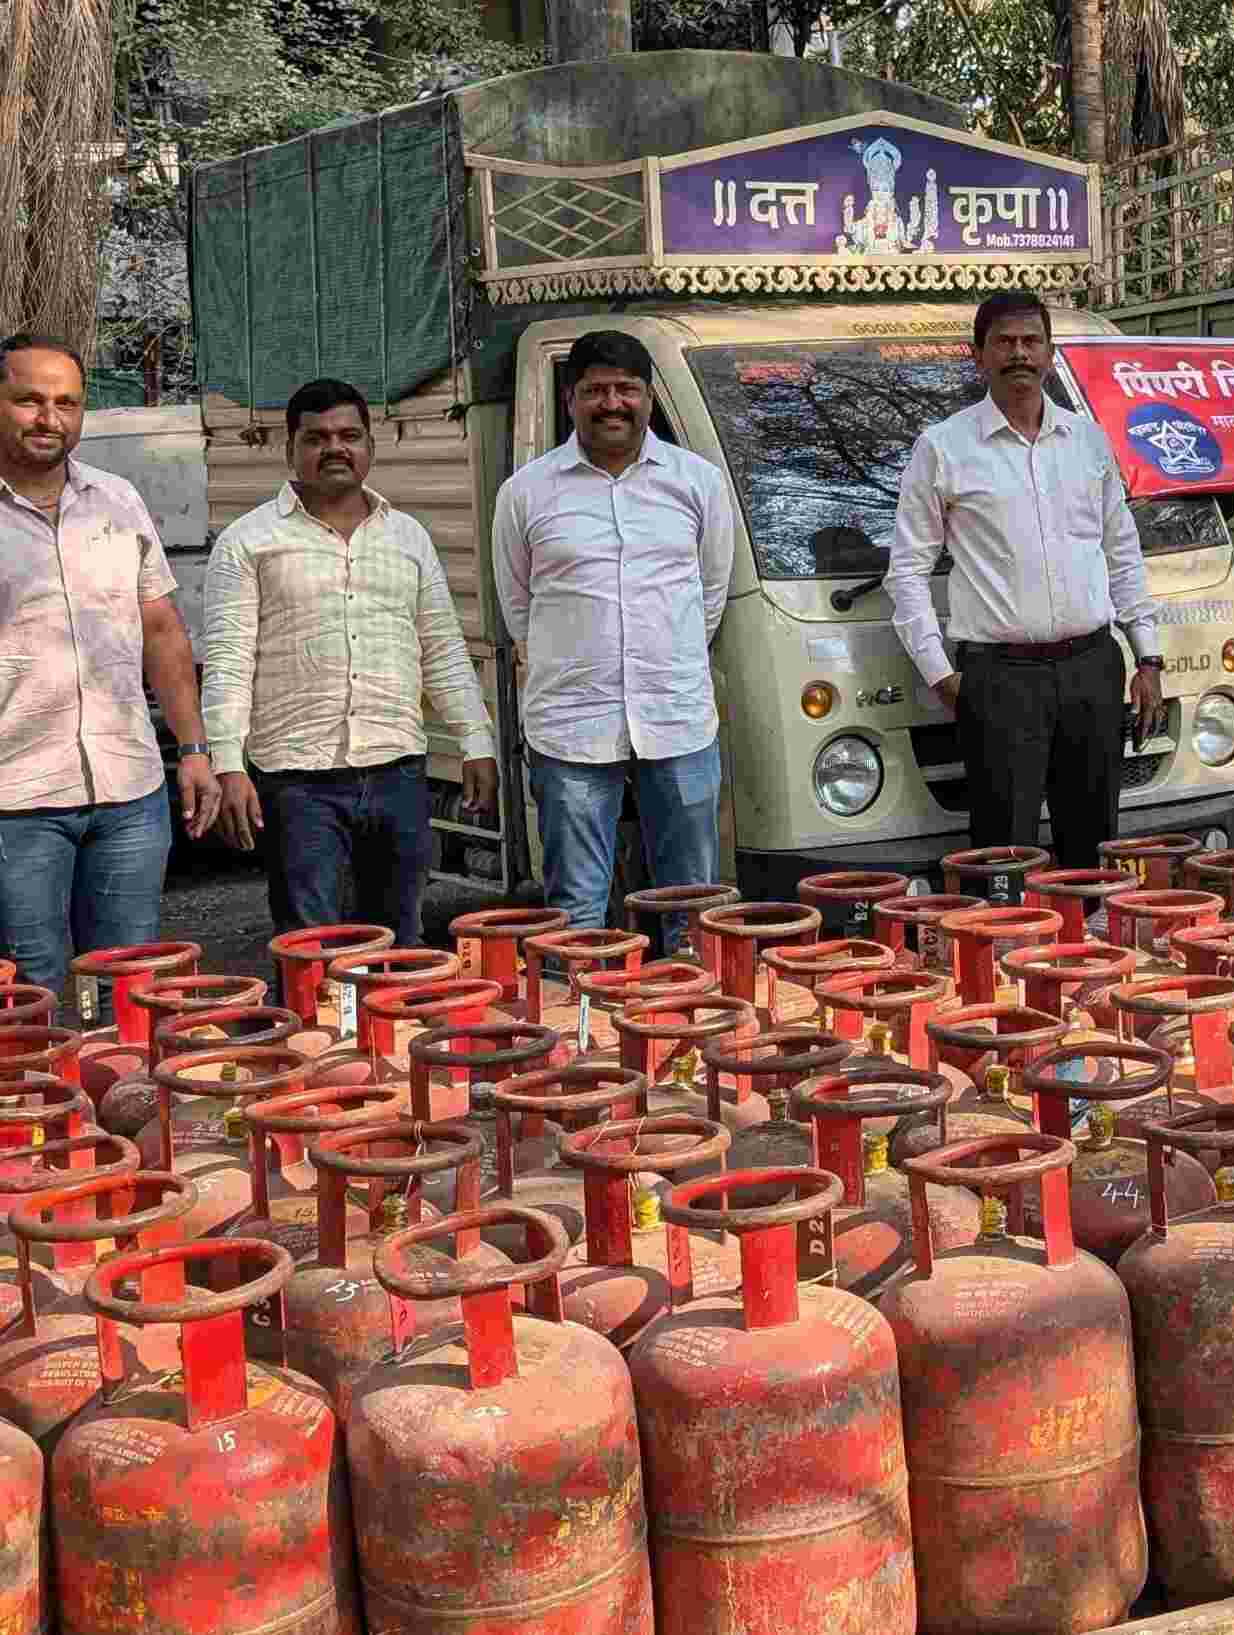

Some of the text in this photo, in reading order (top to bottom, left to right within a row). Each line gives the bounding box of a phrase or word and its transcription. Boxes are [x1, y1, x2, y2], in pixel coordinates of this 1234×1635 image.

[1113, 361, 1210, 398] पिंपरी
[1164, 654, 1212, 673] GOLD
[216, 1430, 236, 1453] 15
